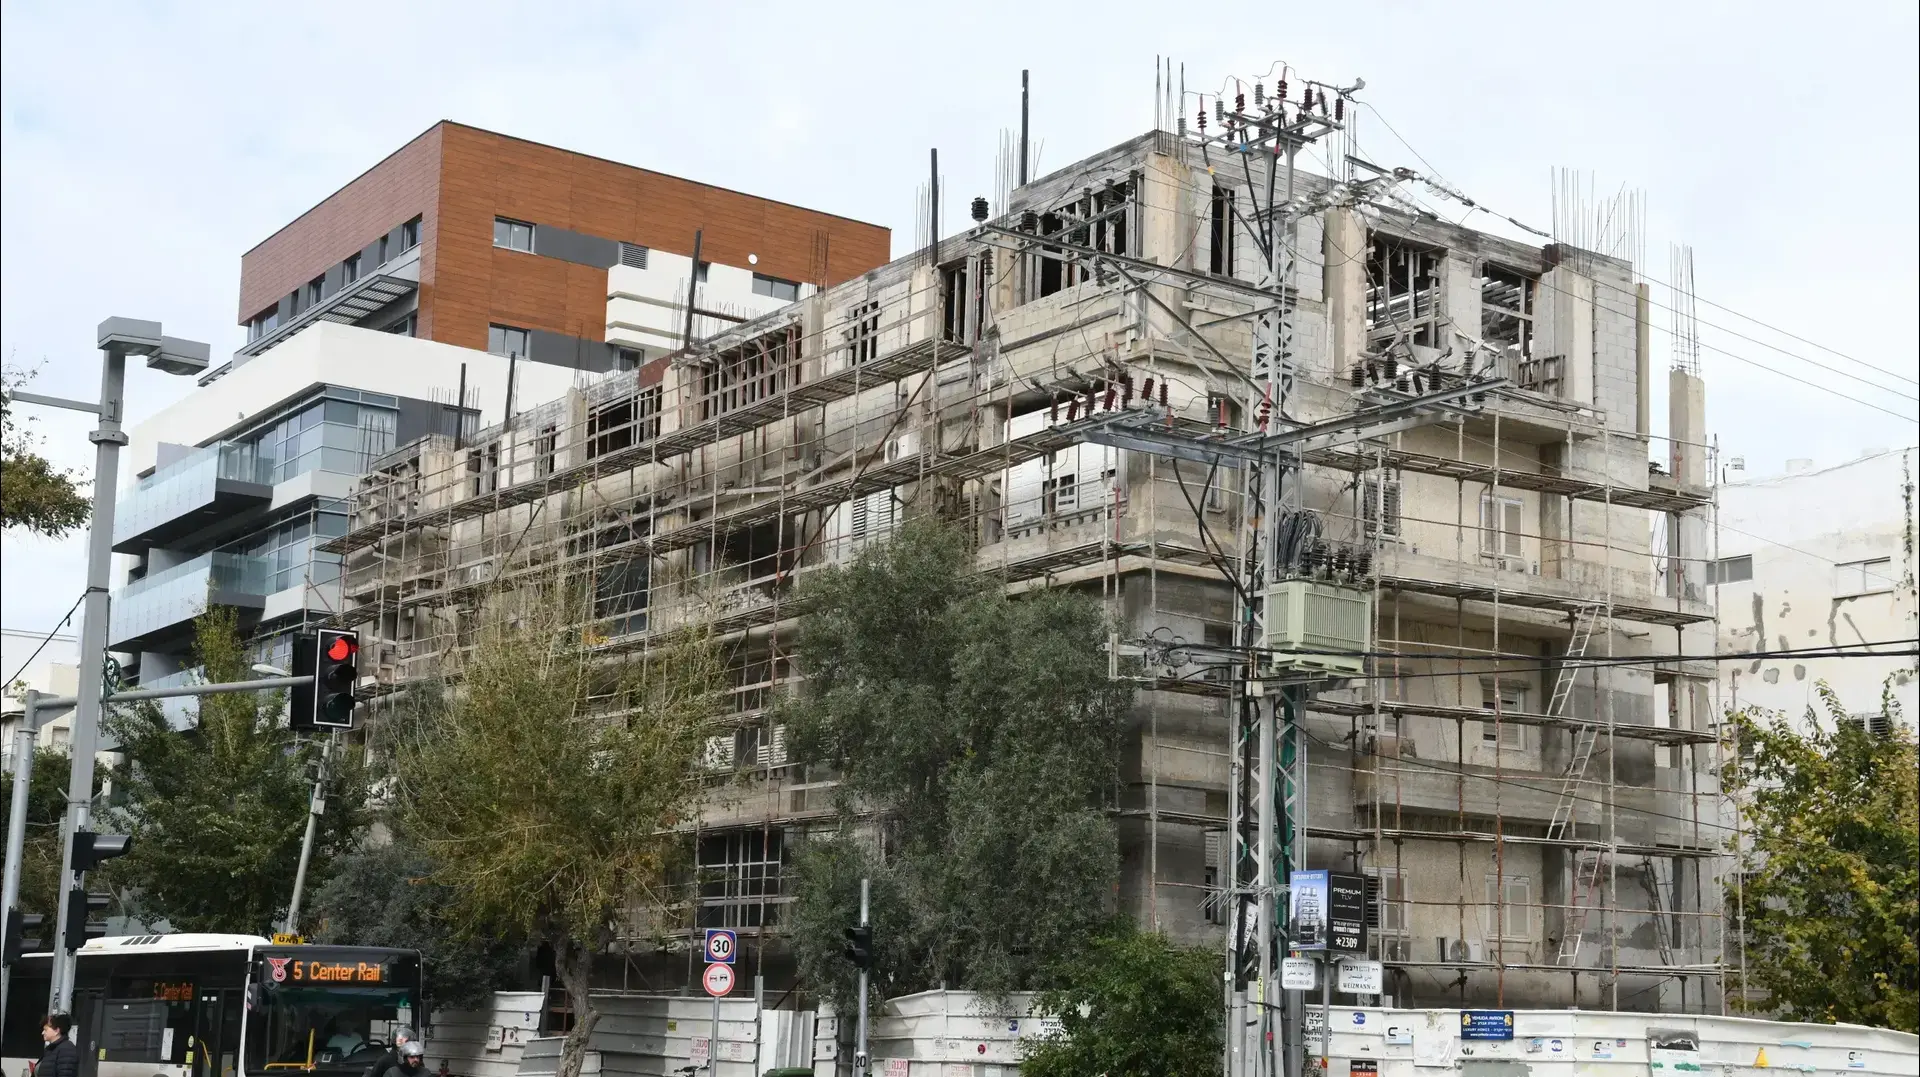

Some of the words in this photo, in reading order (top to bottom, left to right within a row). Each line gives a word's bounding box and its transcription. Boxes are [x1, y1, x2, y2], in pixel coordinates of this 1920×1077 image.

[1333, 887, 1362, 896] PREMIUM
[712, 939, 730, 954] 30
[293, 961, 303, 980] 5
[310, 961, 355, 981] Center
[357, 962, 380, 981] Rail
[1342, 964, 1358, 972] ויצמן
[855, 1056, 866, 1068] 20
